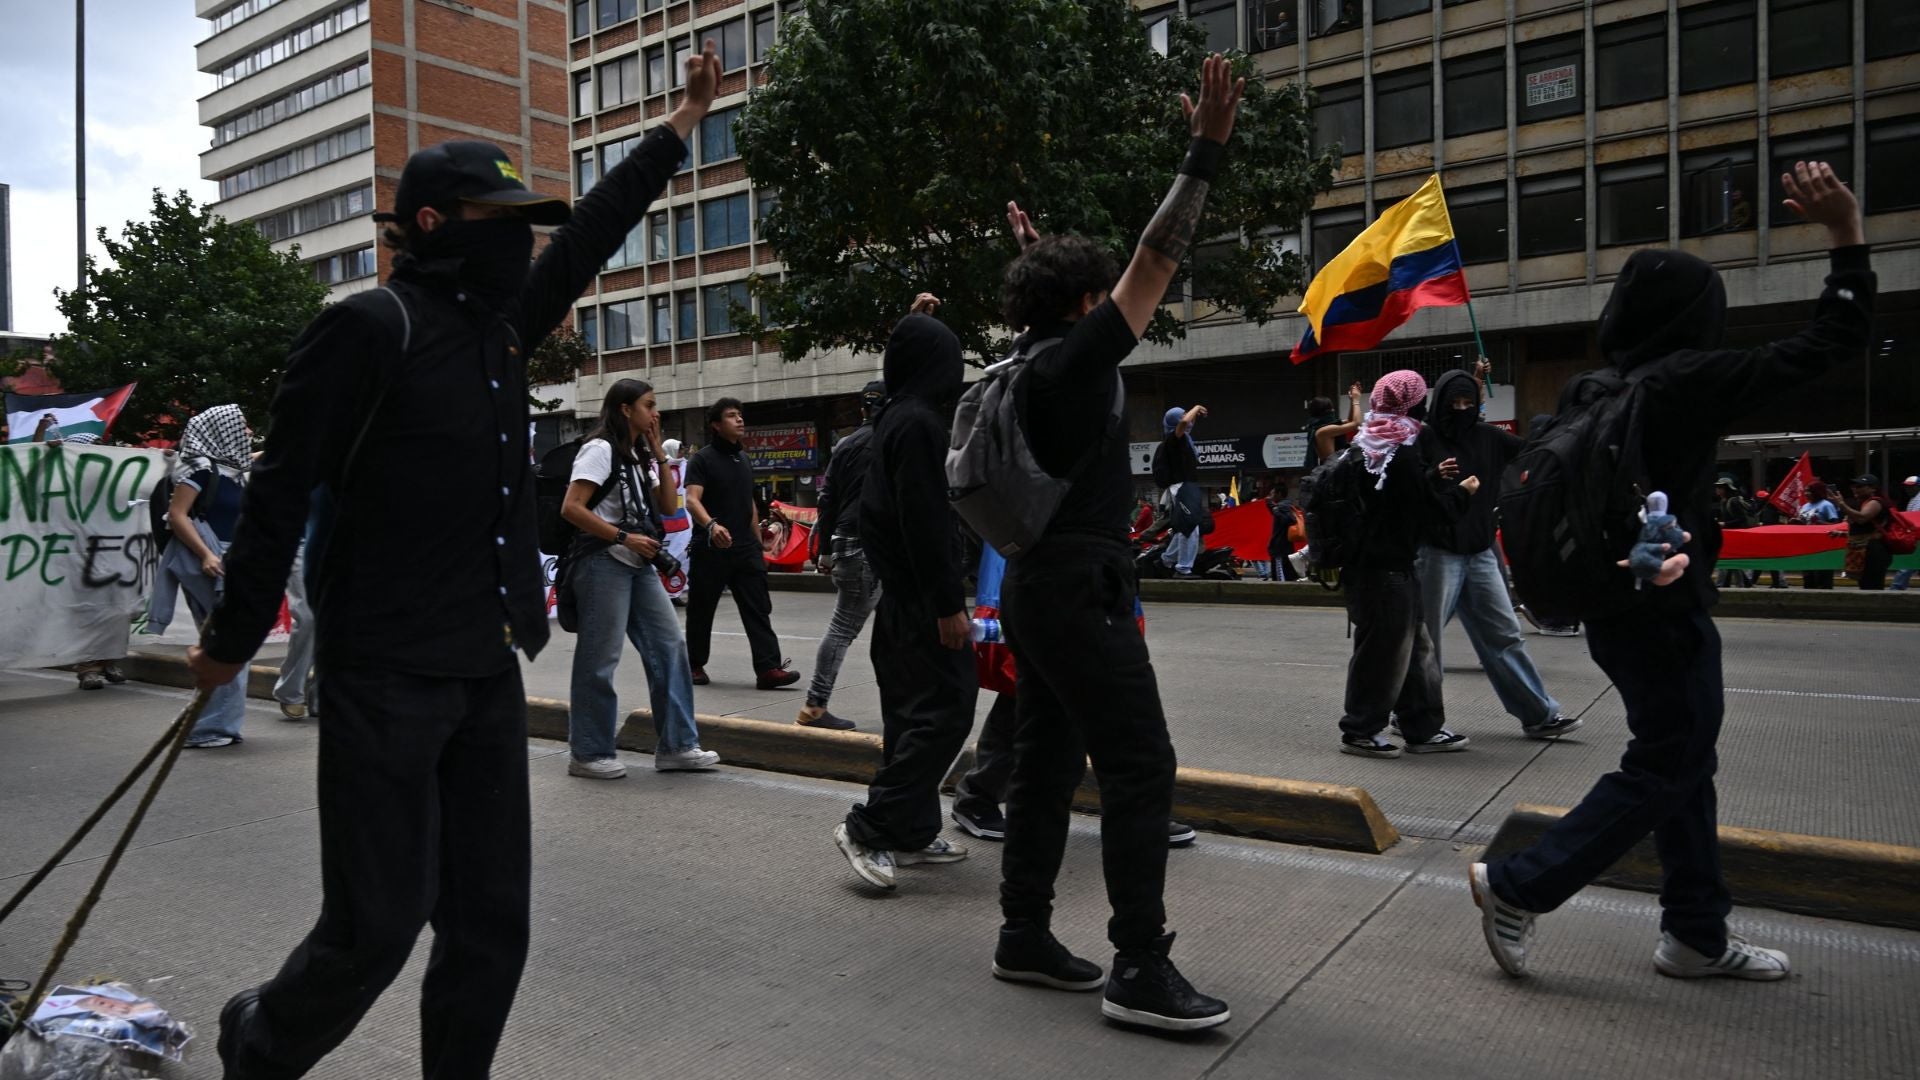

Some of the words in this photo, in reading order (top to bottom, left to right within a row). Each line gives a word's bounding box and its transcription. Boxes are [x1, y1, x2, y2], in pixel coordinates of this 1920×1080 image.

[1539, 67, 1573, 83] ARRIENDA
[1194, 443, 1236, 454] MUNDIAL
[1198, 453, 1246, 464] CAMARAS
[0, 447, 149, 524] NADO
[1, 533, 75, 585] DE
